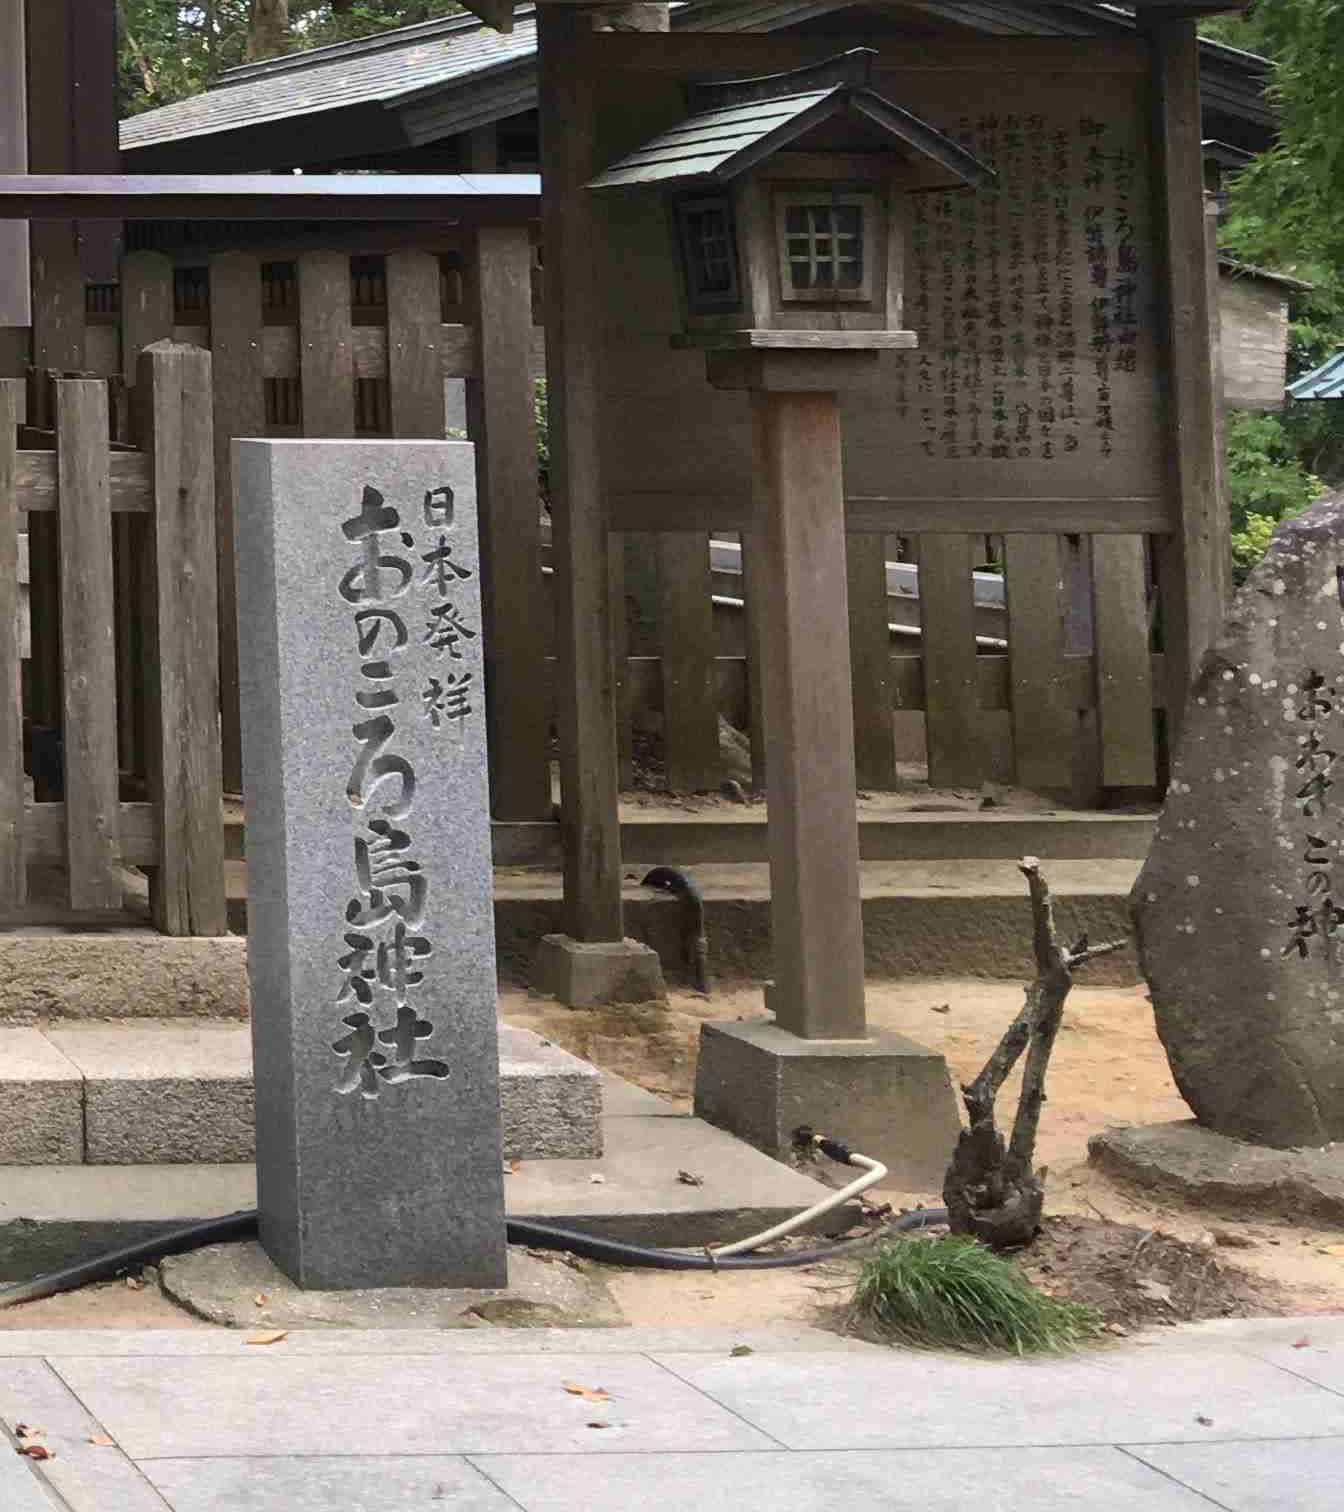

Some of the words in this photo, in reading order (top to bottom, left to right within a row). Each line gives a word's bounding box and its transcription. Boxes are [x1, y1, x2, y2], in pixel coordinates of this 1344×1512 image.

[331, 485, 451, 1099] おのころ島神社
[421, 486, 476, 729] 日本発祥
